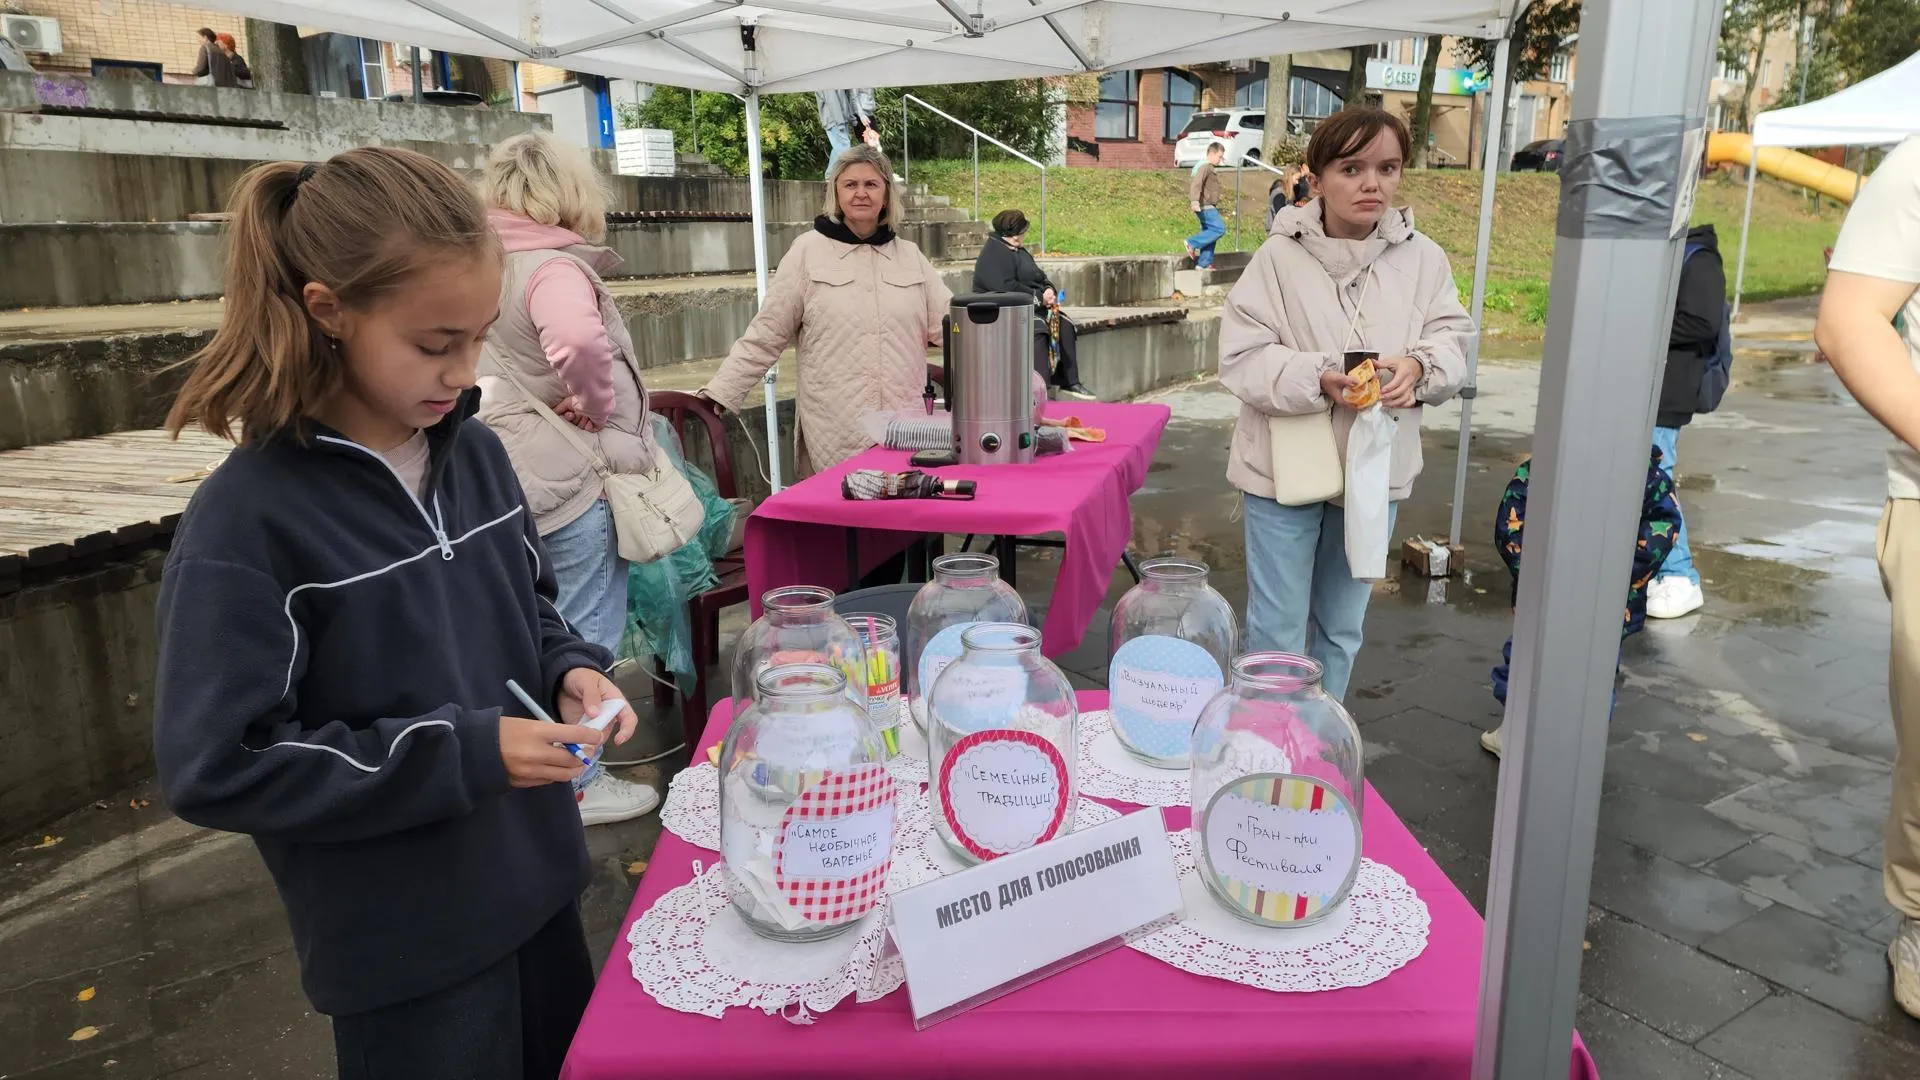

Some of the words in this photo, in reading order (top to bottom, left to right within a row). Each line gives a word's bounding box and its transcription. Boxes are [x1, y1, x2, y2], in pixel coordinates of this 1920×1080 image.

[1395, 70, 1417, 85] СБЕР
[602, 119, 609, 135] 1
[935, 890, 992, 929] МЕСТО
[998, 875, 1033, 909] ДЛЯ
[1036, 836, 1142, 892] ГОЛОСОВАНИЯ
